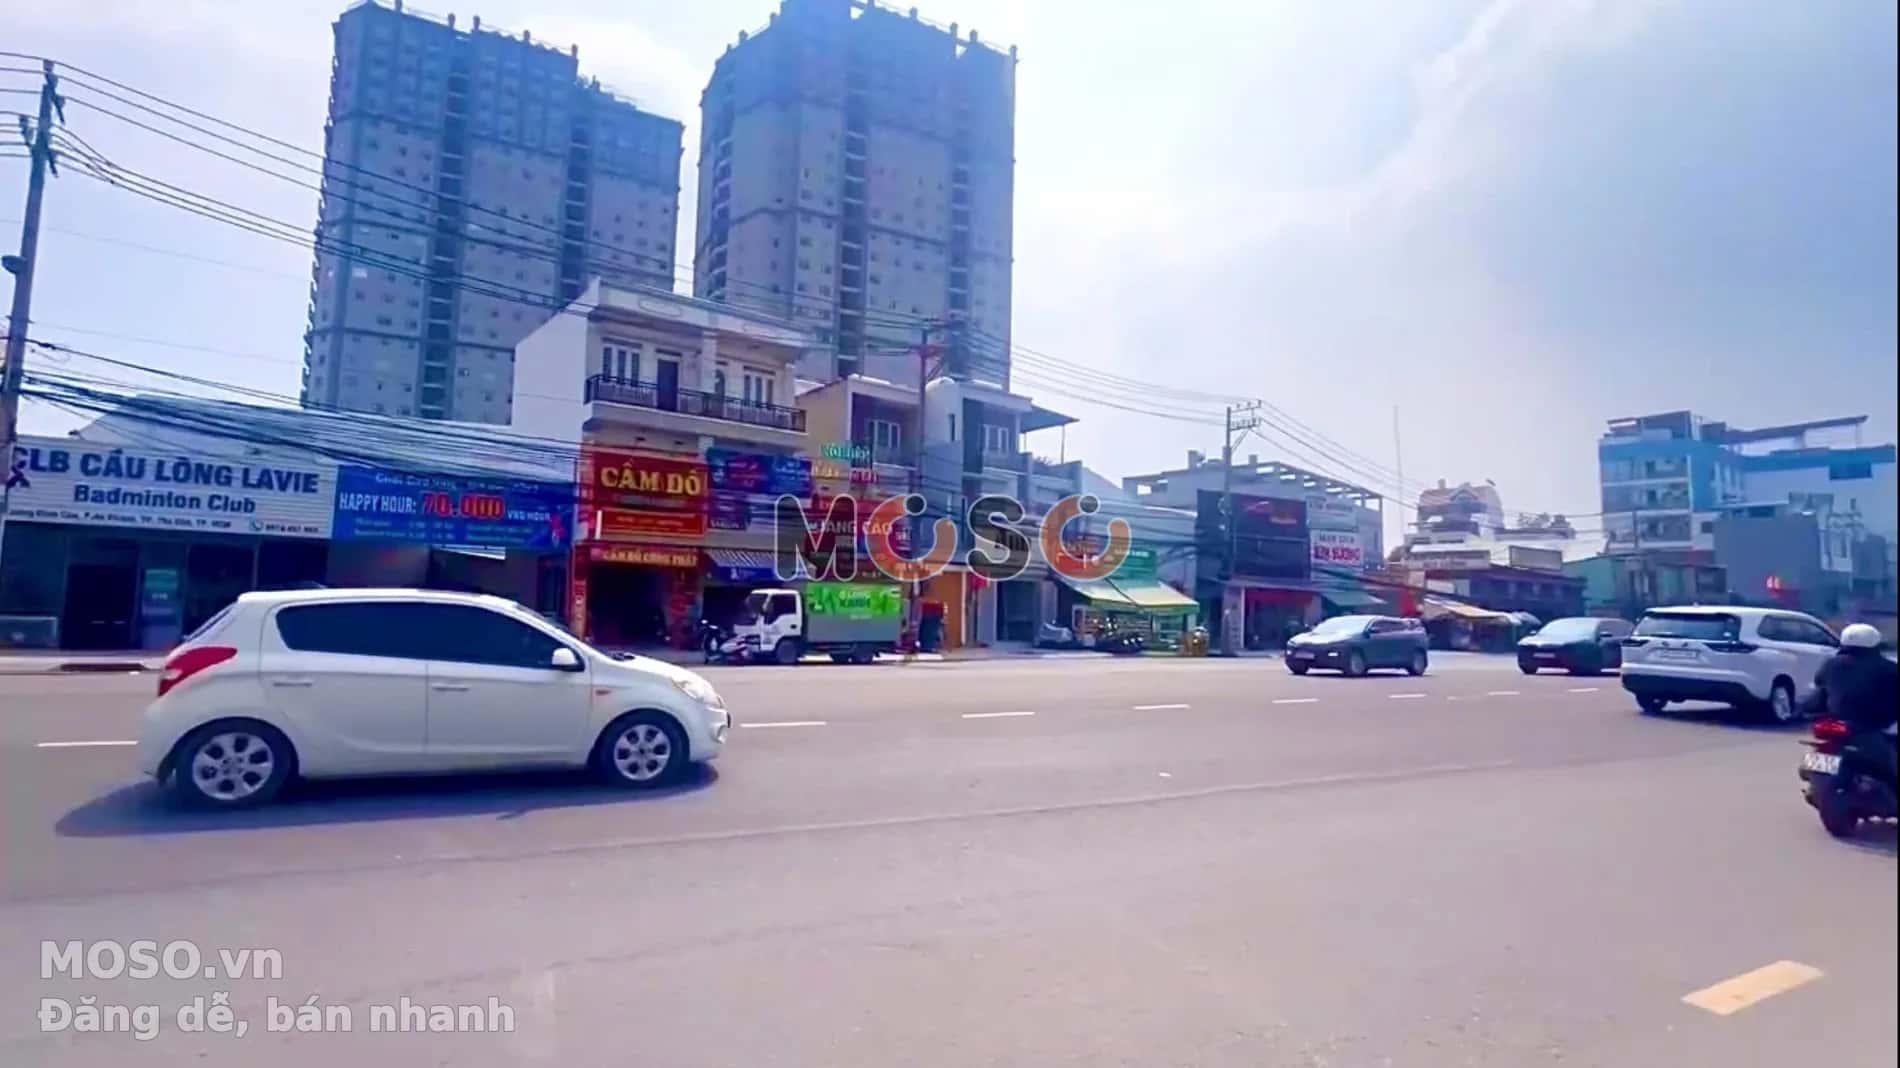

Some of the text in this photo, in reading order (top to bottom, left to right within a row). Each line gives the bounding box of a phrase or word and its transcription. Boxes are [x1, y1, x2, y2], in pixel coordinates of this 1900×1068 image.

[242, 466, 320, 493] LAVIE
[74, 484, 256, 514] Badminton Club
[340, 492, 379, 511] HAPPY
[381, 495, 417, 514] HOUR:
